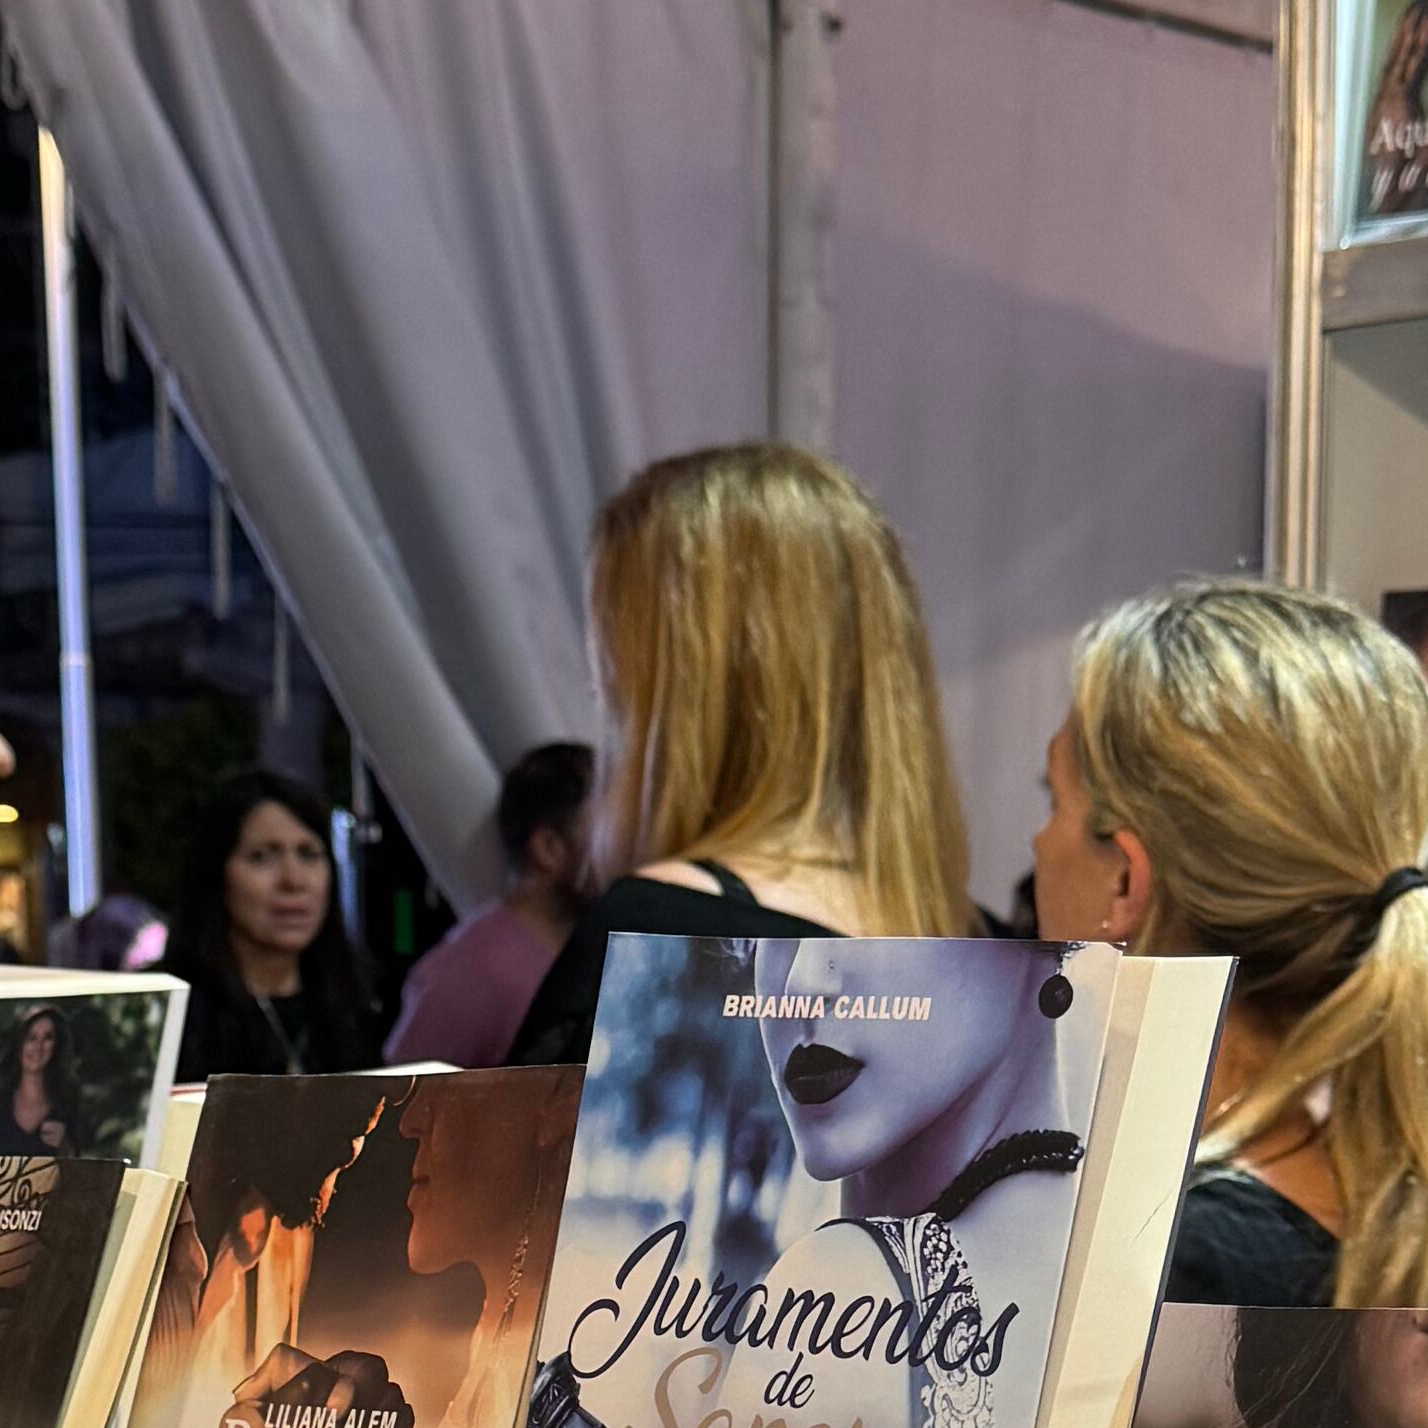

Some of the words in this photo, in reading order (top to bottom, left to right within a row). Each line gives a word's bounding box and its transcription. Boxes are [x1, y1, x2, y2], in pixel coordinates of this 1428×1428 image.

[722, 994, 825, 1019] BRIANNA
[833, 994, 932, 1021] CALLUM
[568, 1220, 1020, 1379] Juramentos
[763, 1352, 816, 1409] de
